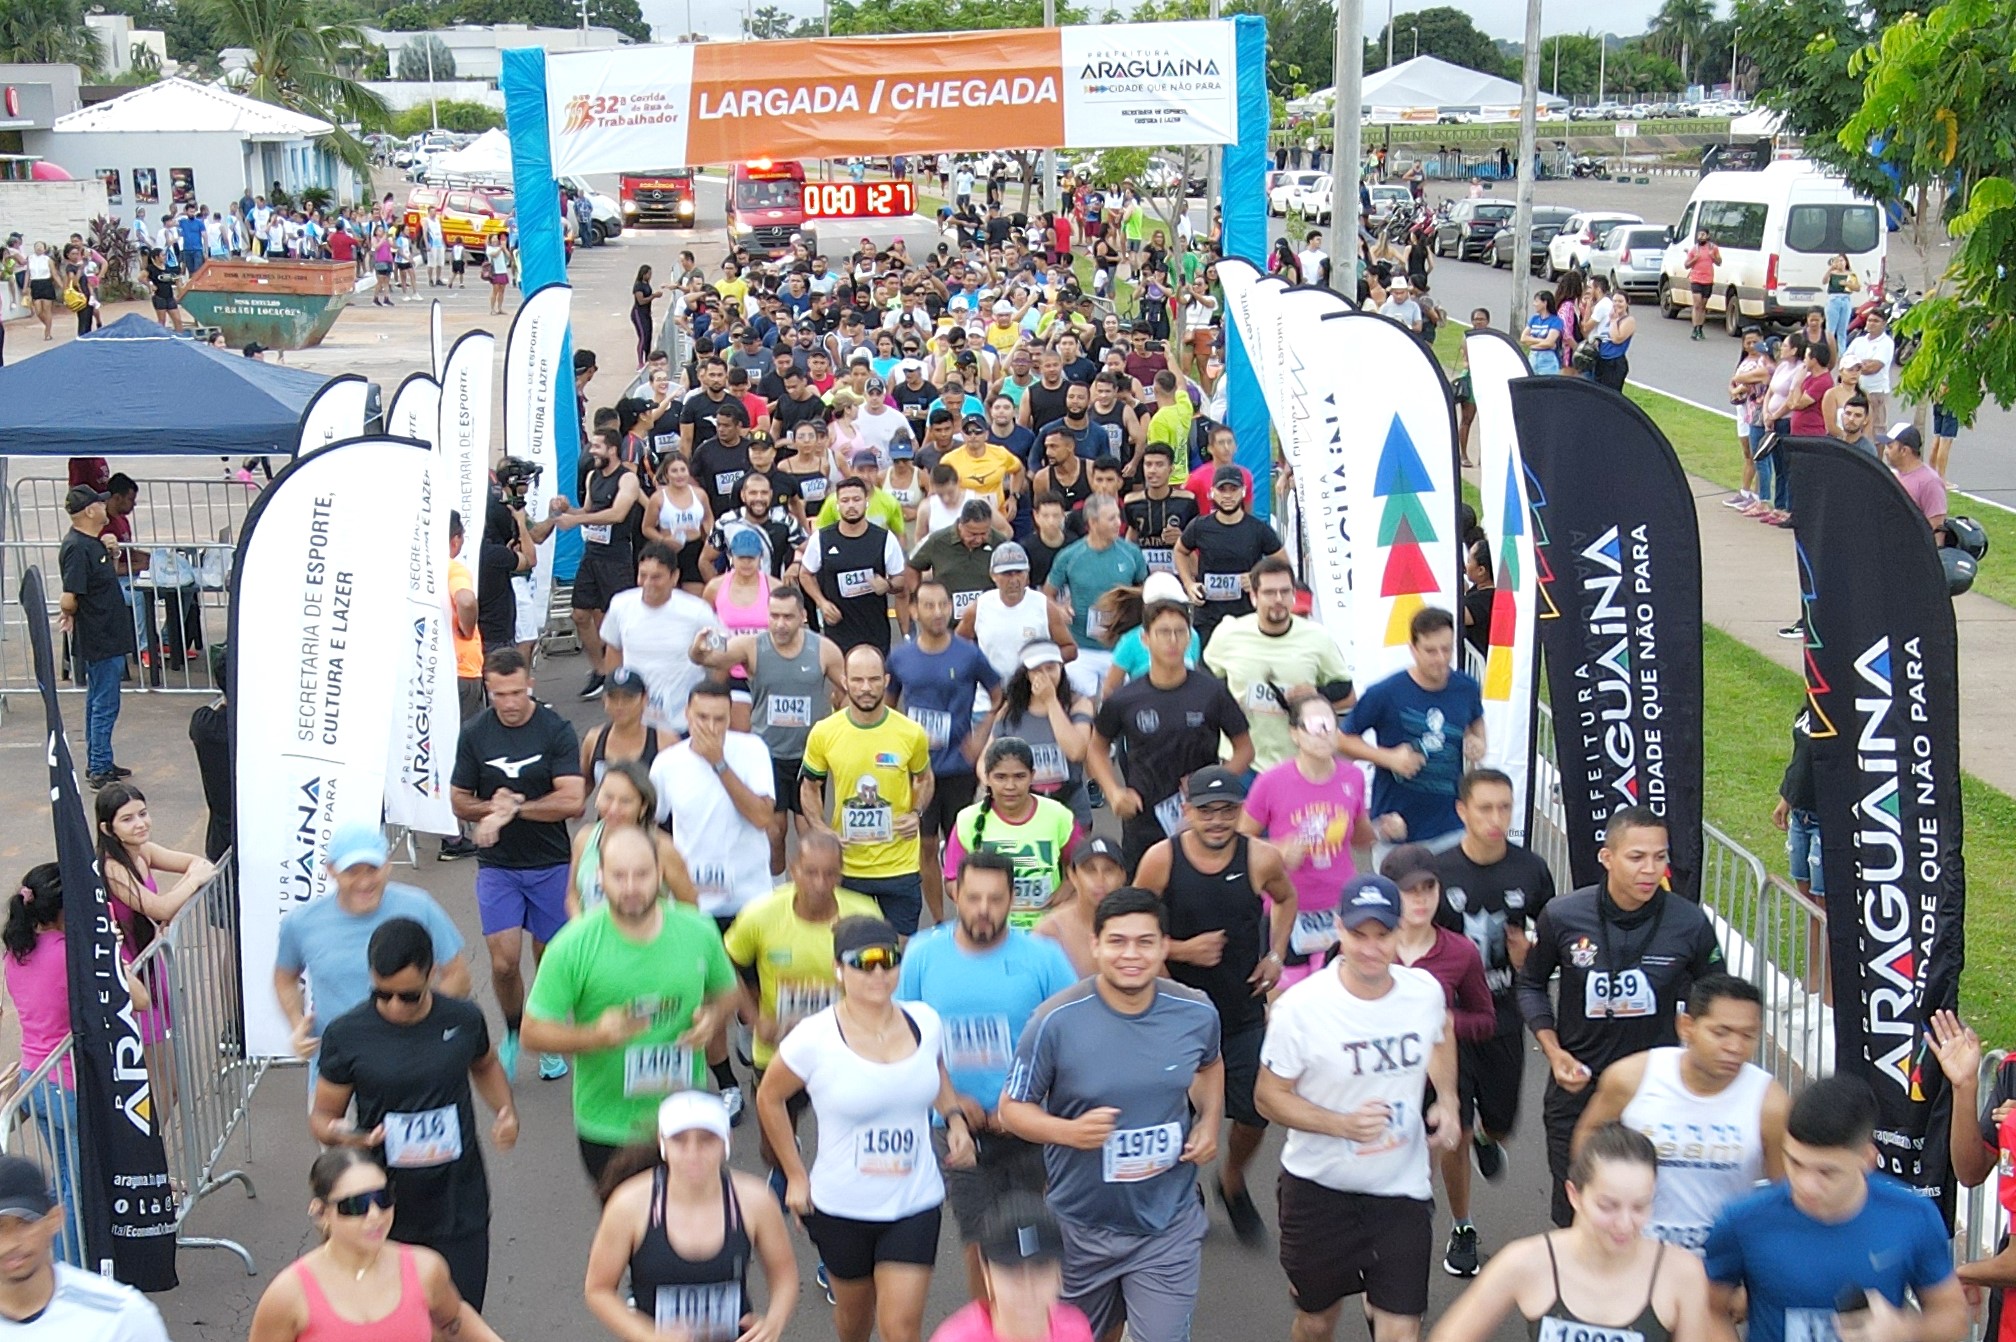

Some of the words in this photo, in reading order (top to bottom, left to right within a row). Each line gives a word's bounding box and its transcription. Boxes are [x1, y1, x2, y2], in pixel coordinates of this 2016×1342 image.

[1080, 58, 1221, 80] ARAGUAÍNA
[1087, 50, 1170, 58] PREFEITURA
[698, 84, 861, 120] LARGADA
[867, 79, 886, 114] /
[890, 76, 1058, 111] CHEGADA
[1108, 84, 1144, 93] CIDADE
[1147, 83, 1168, 93] QUE
[1170, 82, 1193, 92] NÃO
[1195, 81, 1222, 90] PARA
[598, 113, 680, 128] Trabalhador
[538, 358, 548, 393] LAZER
[459, 366, 469, 427] ESPORTE,
[538, 395, 546, 403] E
[459, 430, 472, 447] DE
[532, 405, 546, 455] CULTURA
[459, 451, 473, 528] SECRETARIA
[306, 491, 337, 587] ESPORTE,
[1148, 552, 1172, 563] 1118
[1319, 474, 1347, 609] PREFEITURA
[1630, 524, 1652, 593] PARA
[845, 571, 867, 585] 811
[1210, 576, 1236, 589] 2267
[303, 591, 323, 616] DE
[331, 570, 354, 632] LAZER
[329, 637, 346, 651] E
[430, 618, 439, 652] PARA
[1635, 604, 1657, 659] NÃO
[298, 619, 321, 743] SECRETARIA
[426, 656, 438, 684] NÃO
[1903, 636, 1929, 722] PARA
[323, 658, 345, 746] CULTURA
[774, 698, 805, 713] 1042
[1640, 669, 1663, 720] QUE
[1644, 729, 1667, 817] CIDADE
[1911, 734, 1936, 805] NÃO
[323, 777, 338, 823] PARA
[848, 810, 883, 828] 2227
[320, 828, 333, 865] NÃO
[1853, 635, 1916, 1096] ARAGUAÍNA
[1919, 817, 1942, 882] QUE
[1344, 1033, 1421, 1076] TXC
[863, 1129, 914, 1154] 1509
[1116, 1128, 1169, 1158] 1979
